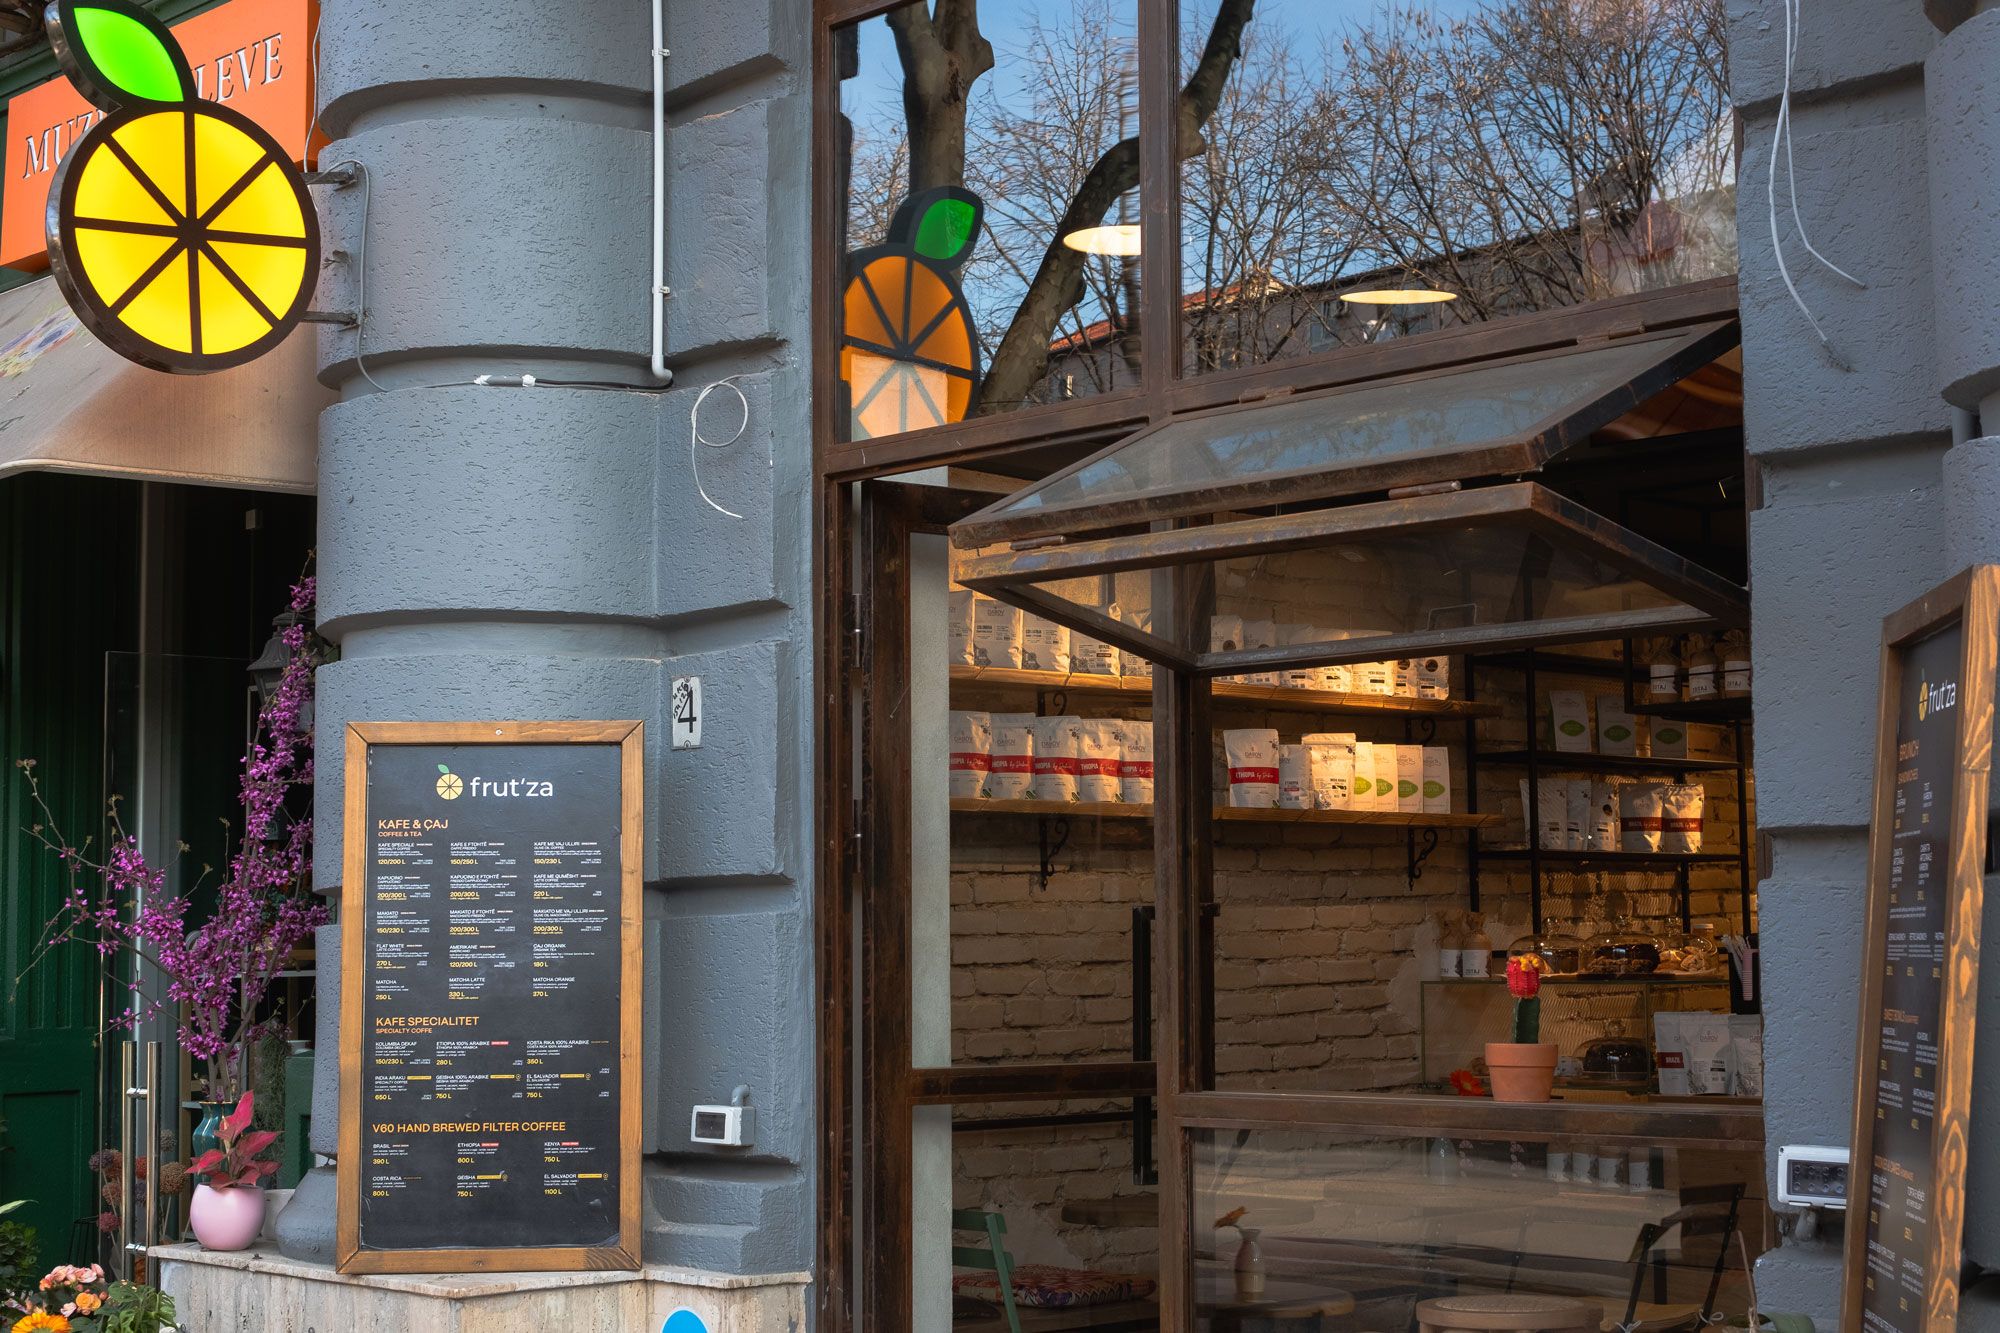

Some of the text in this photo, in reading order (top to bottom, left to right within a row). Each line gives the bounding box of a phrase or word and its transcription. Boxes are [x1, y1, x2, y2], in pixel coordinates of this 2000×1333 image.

[22, 33, 283, 179] MUZ LEVE
[1928, 680, 1956, 714] frut'za
[678, 687, 697, 733] 4
[470, 777, 553, 797] frut'za
[378, 819, 449, 831] KAFE & ÇAJ
[376, 1016, 479, 1026] KAFE SPECIALITET
[372, 1121, 566, 1133] V60 HAND BREWED FILTER COFFEE
